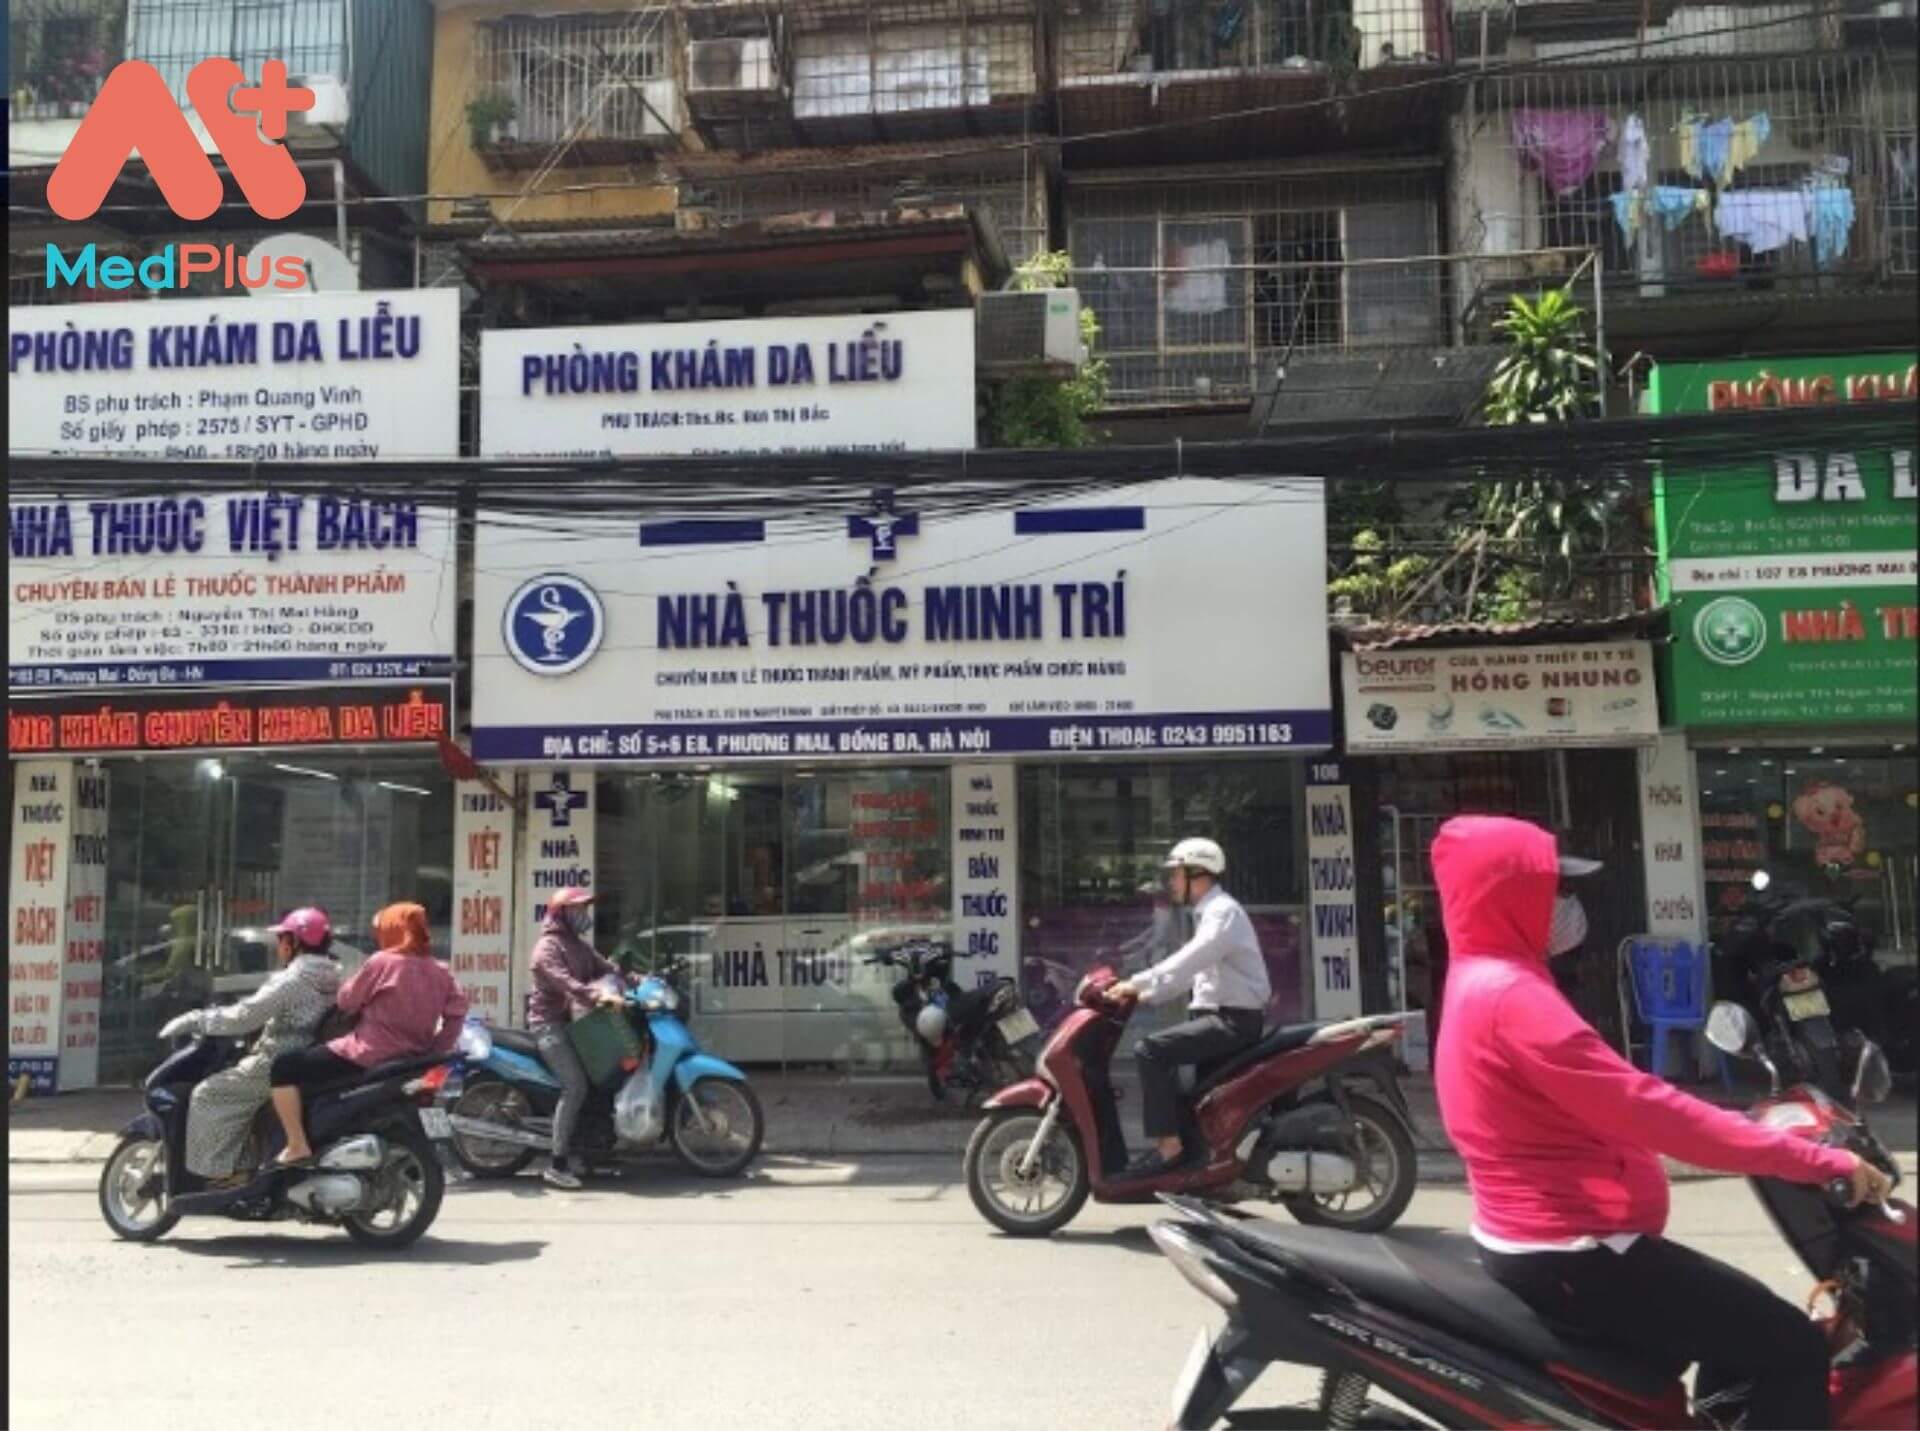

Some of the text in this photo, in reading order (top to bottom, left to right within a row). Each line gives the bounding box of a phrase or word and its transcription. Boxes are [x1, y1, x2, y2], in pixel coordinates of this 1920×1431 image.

[9, 301, 421, 373] PHÒNG KHÁM DA LIỄU
[522, 321, 903, 397] PHÒNG KHÁM DA LIỄU
[255, 388, 315, 409] Quang
[319, 385, 362, 405] Vinh
[255, 414, 295, 434] SYT
[15, 576, 98, 603] CHUYÊN
[103, 574, 146, 600] BÁN
[186, 568, 257, 597] THUỐC
[657, 566, 1127, 649] NHÀ THUỐC MINH TRÍ
[1780, 597, 1866, 641] NHÀ
[1541, 667, 1642, 688] NHUNG
[618, 728, 644, 754] SỐ
[928, 726, 954, 750] HÀ
[958, 725, 991, 754] NỘI
[1049, 724, 1095, 752] ĐIỆN
[1161, 725, 1208, 745] 0243
[540, 834, 580, 858] NHÀ
[531, 862, 592, 888] THUỐC
[968, 852, 999, 880] BÁN
[460, 889, 503, 936] BÁCH
[961, 886, 1008, 918] THUỐC
[712, 942, 769, 988] NHÀ
